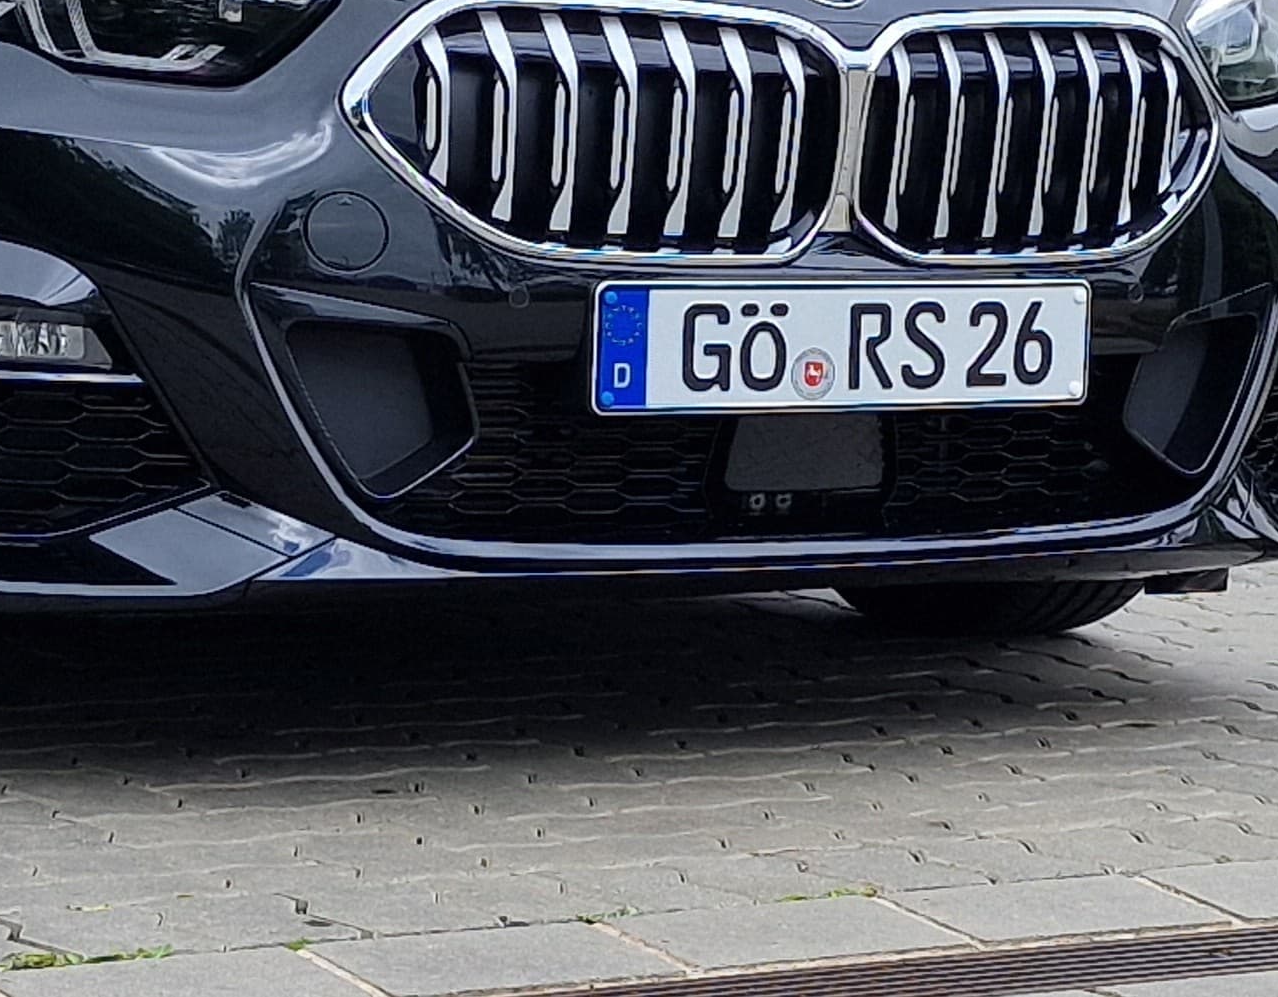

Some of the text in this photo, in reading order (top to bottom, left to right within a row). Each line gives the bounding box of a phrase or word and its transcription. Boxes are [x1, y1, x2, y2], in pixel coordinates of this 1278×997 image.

[613, 300, 1053, 392] D GÖ RS 26
